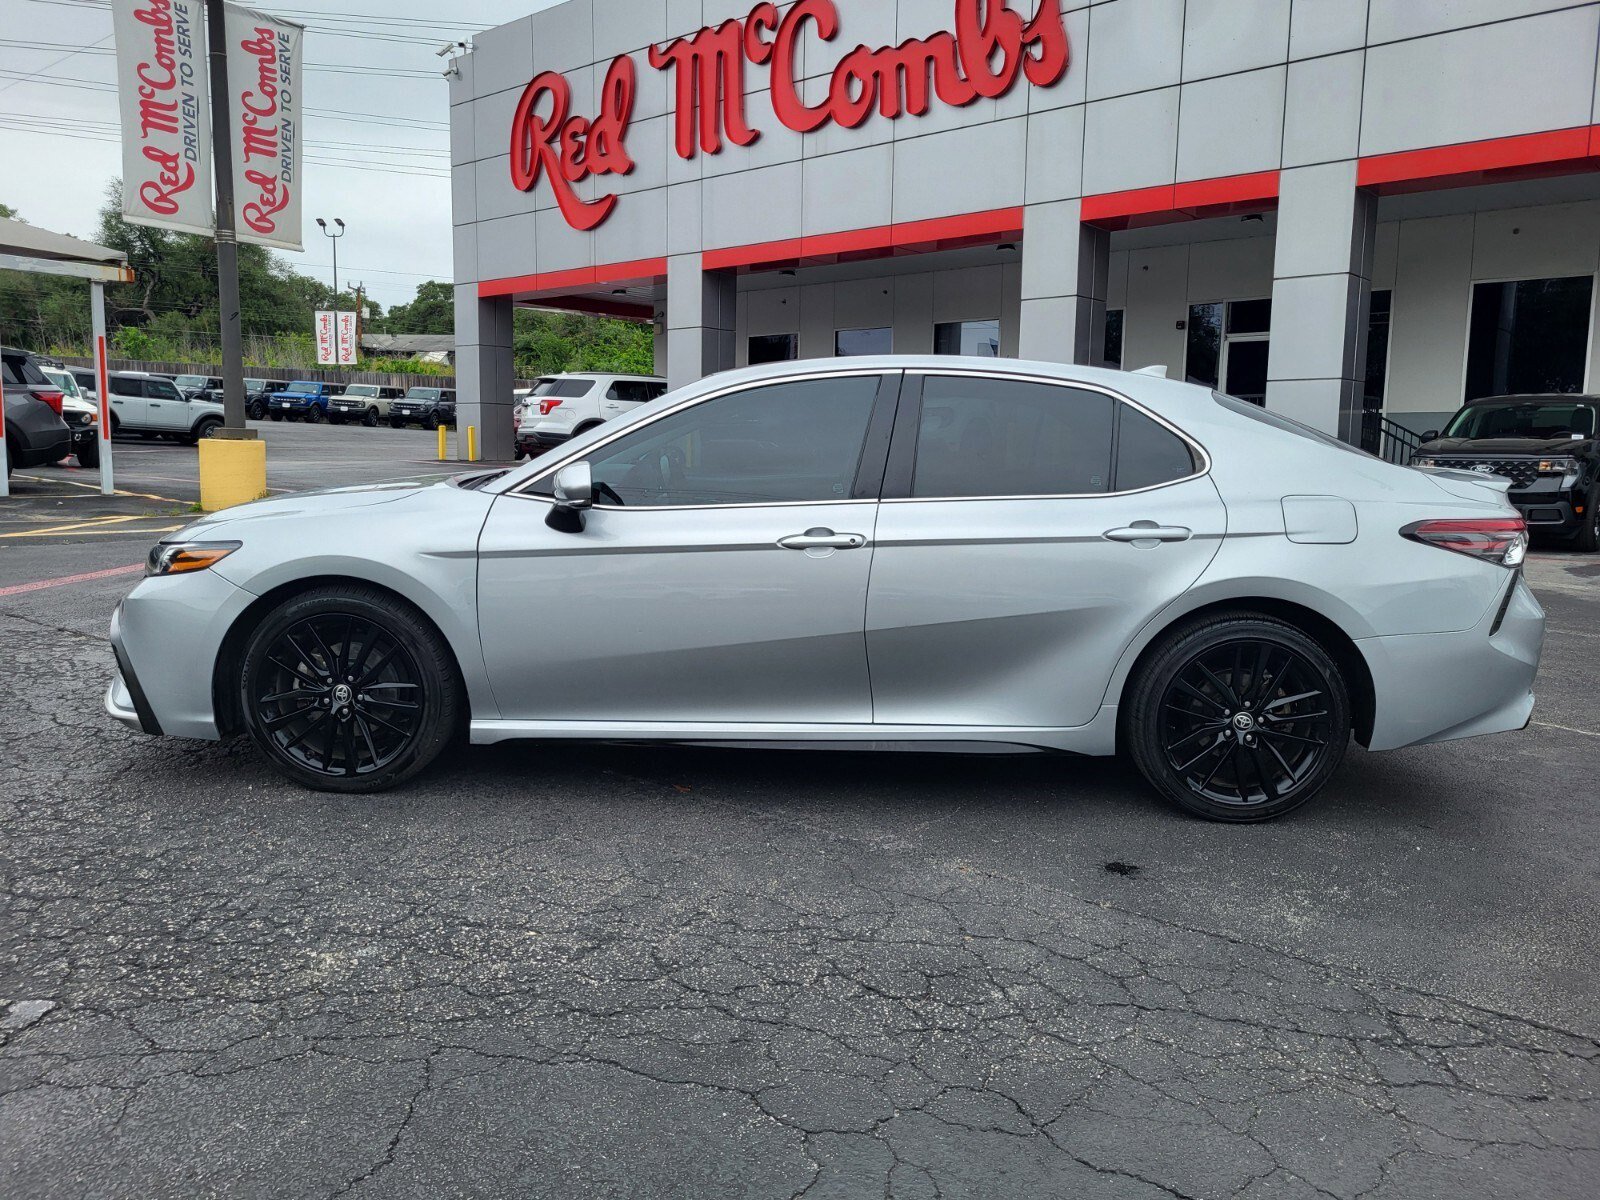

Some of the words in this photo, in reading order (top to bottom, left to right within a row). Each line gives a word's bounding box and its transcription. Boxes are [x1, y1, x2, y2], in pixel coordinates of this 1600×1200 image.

[174, 2, 192, 59] SERVE
[277, 31, 291, 86] SERVE
[133, 0, 179, 138] McCombs
[180, 62, 195, 87] TO
[240, 27, 278, 163] McCombs
[279, 89, 292, 113] TO
[179, 92, 198, 163] DRIVEN
[510, 54, 637, 231] Red
[648, 0, 1070, 160] McCombs
[139, 145, 195, 215] Red
[279, 119, 292, 183] DRIVEN
[242, 169, 290, 234] Red
[321, 347, 331, 361] Red
[341, 347, 352, 361] Red
